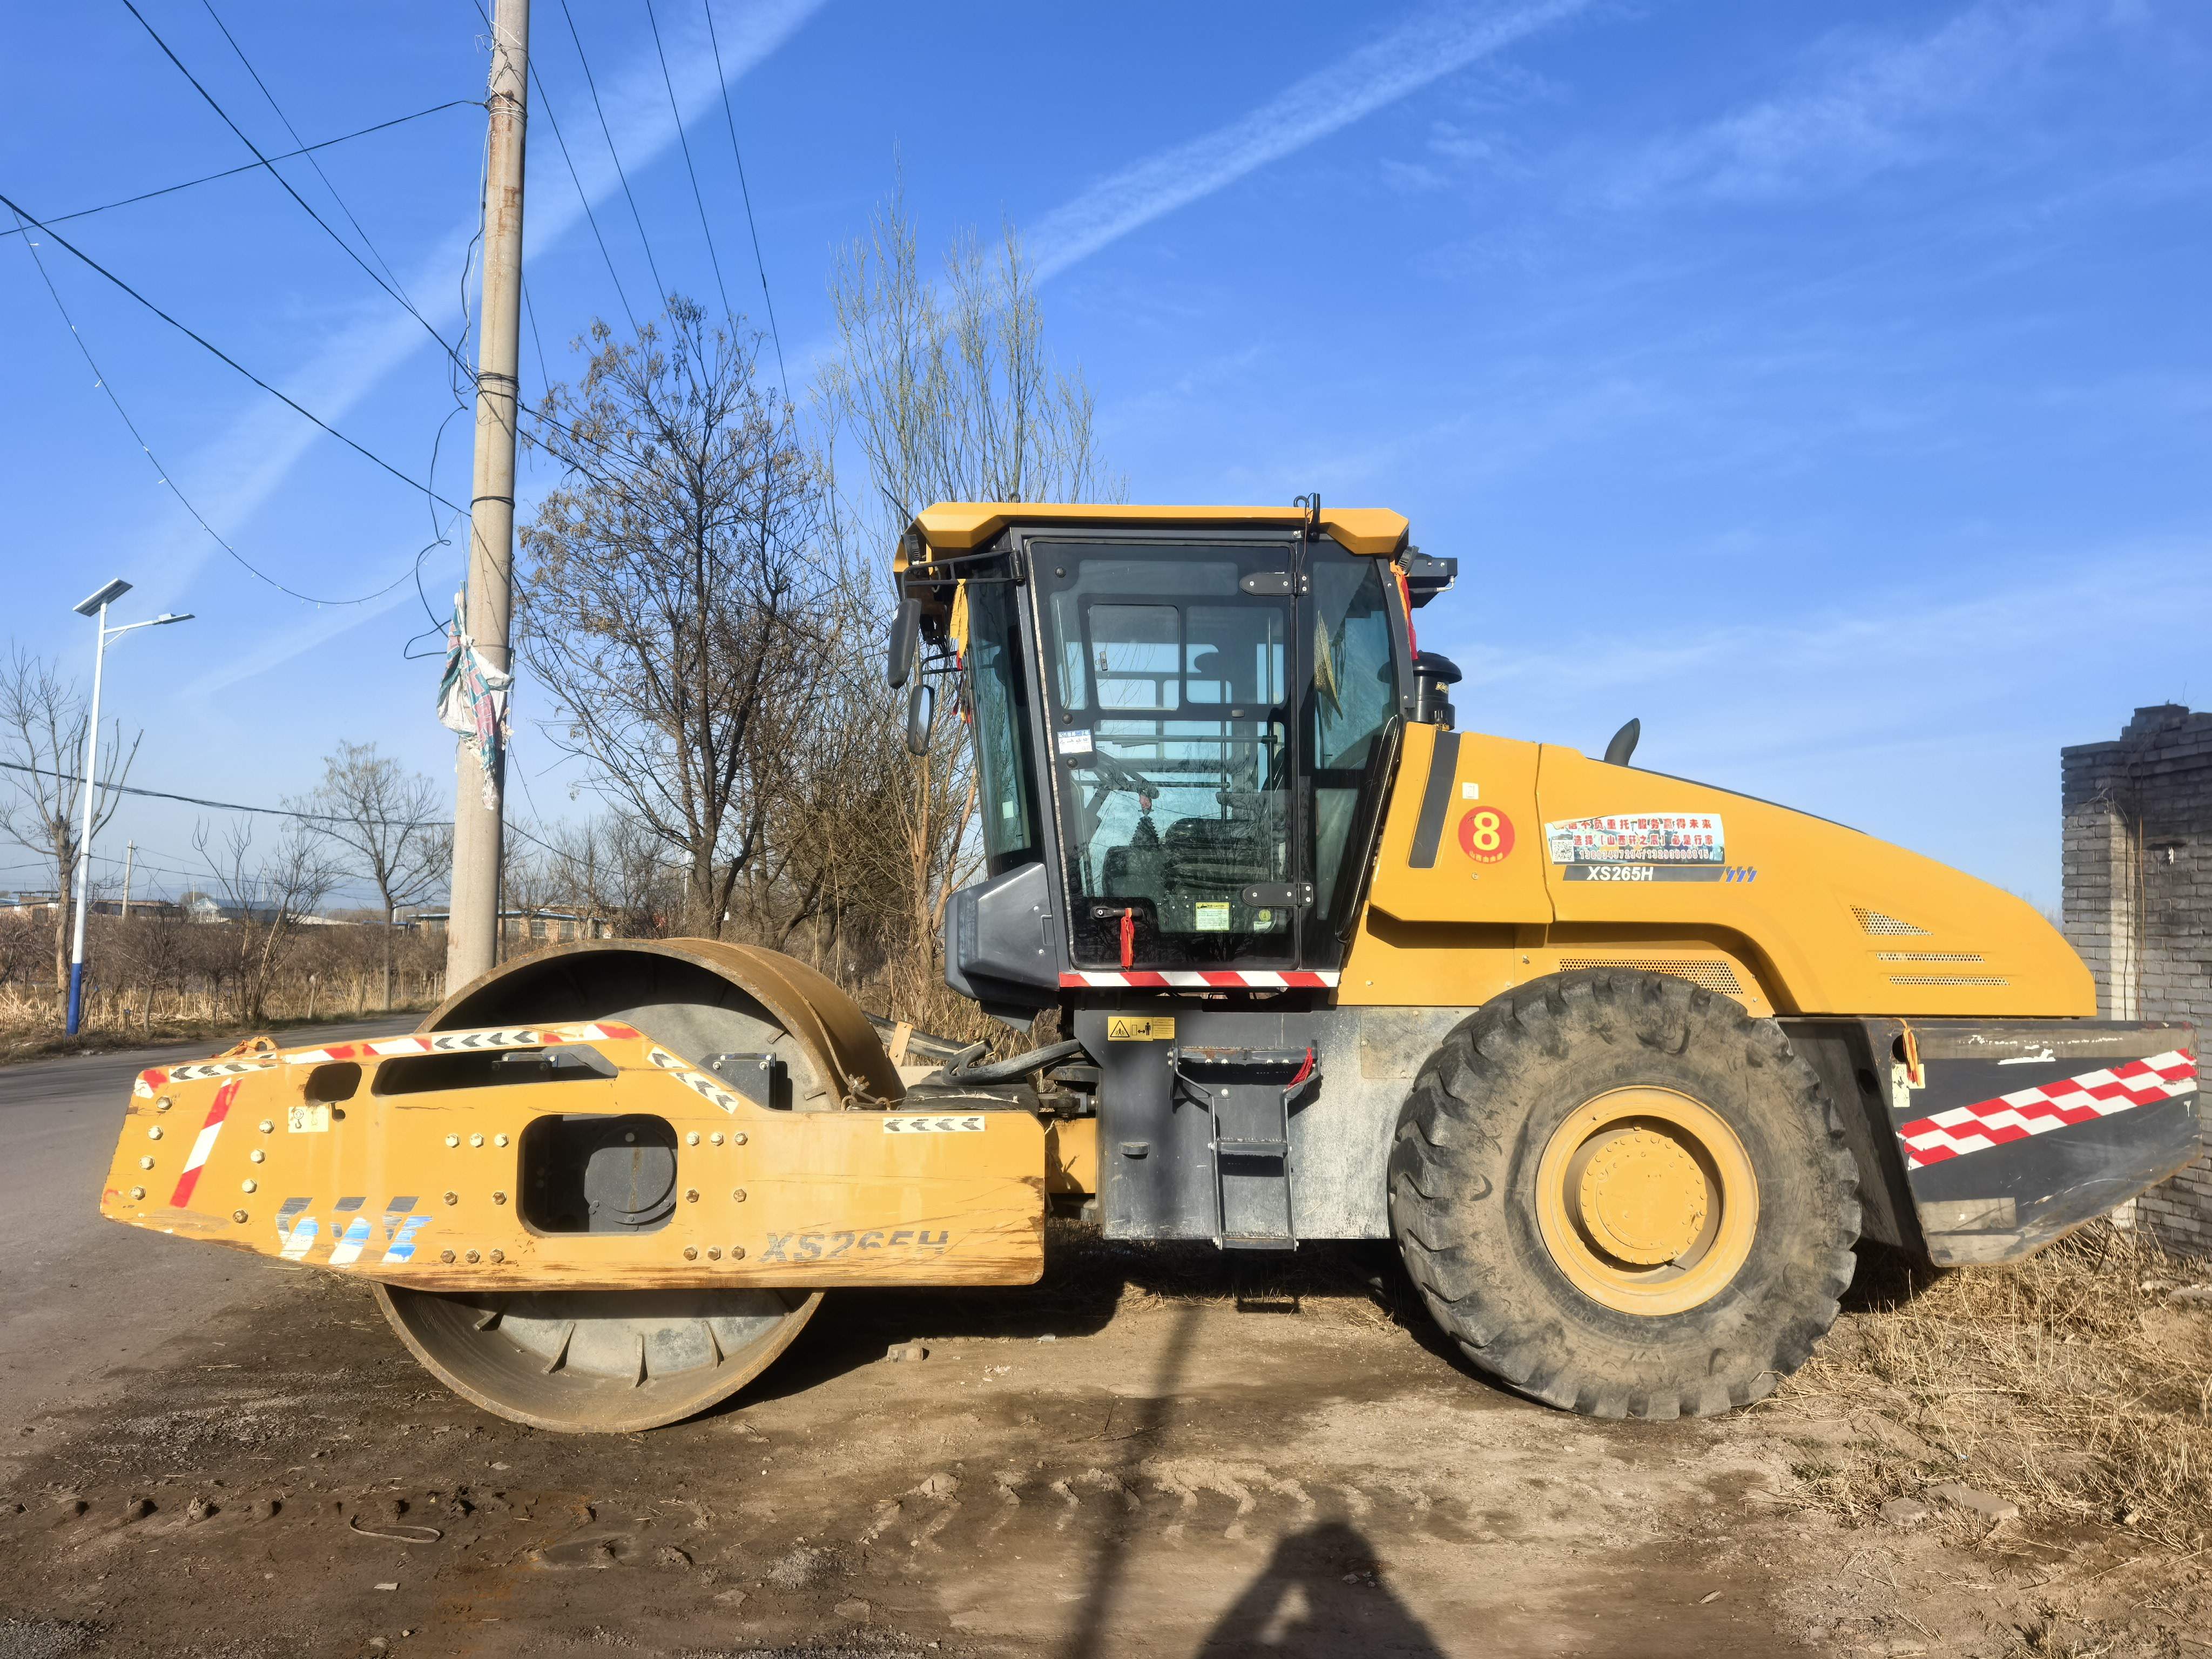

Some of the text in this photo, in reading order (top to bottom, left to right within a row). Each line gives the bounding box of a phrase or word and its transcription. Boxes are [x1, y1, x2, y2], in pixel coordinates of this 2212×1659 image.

[1473, 811, 1500, 851] 8
[1555, 819, 1630, 830] 信不负重托
[1586, 866, 1654, 881] XS265H
